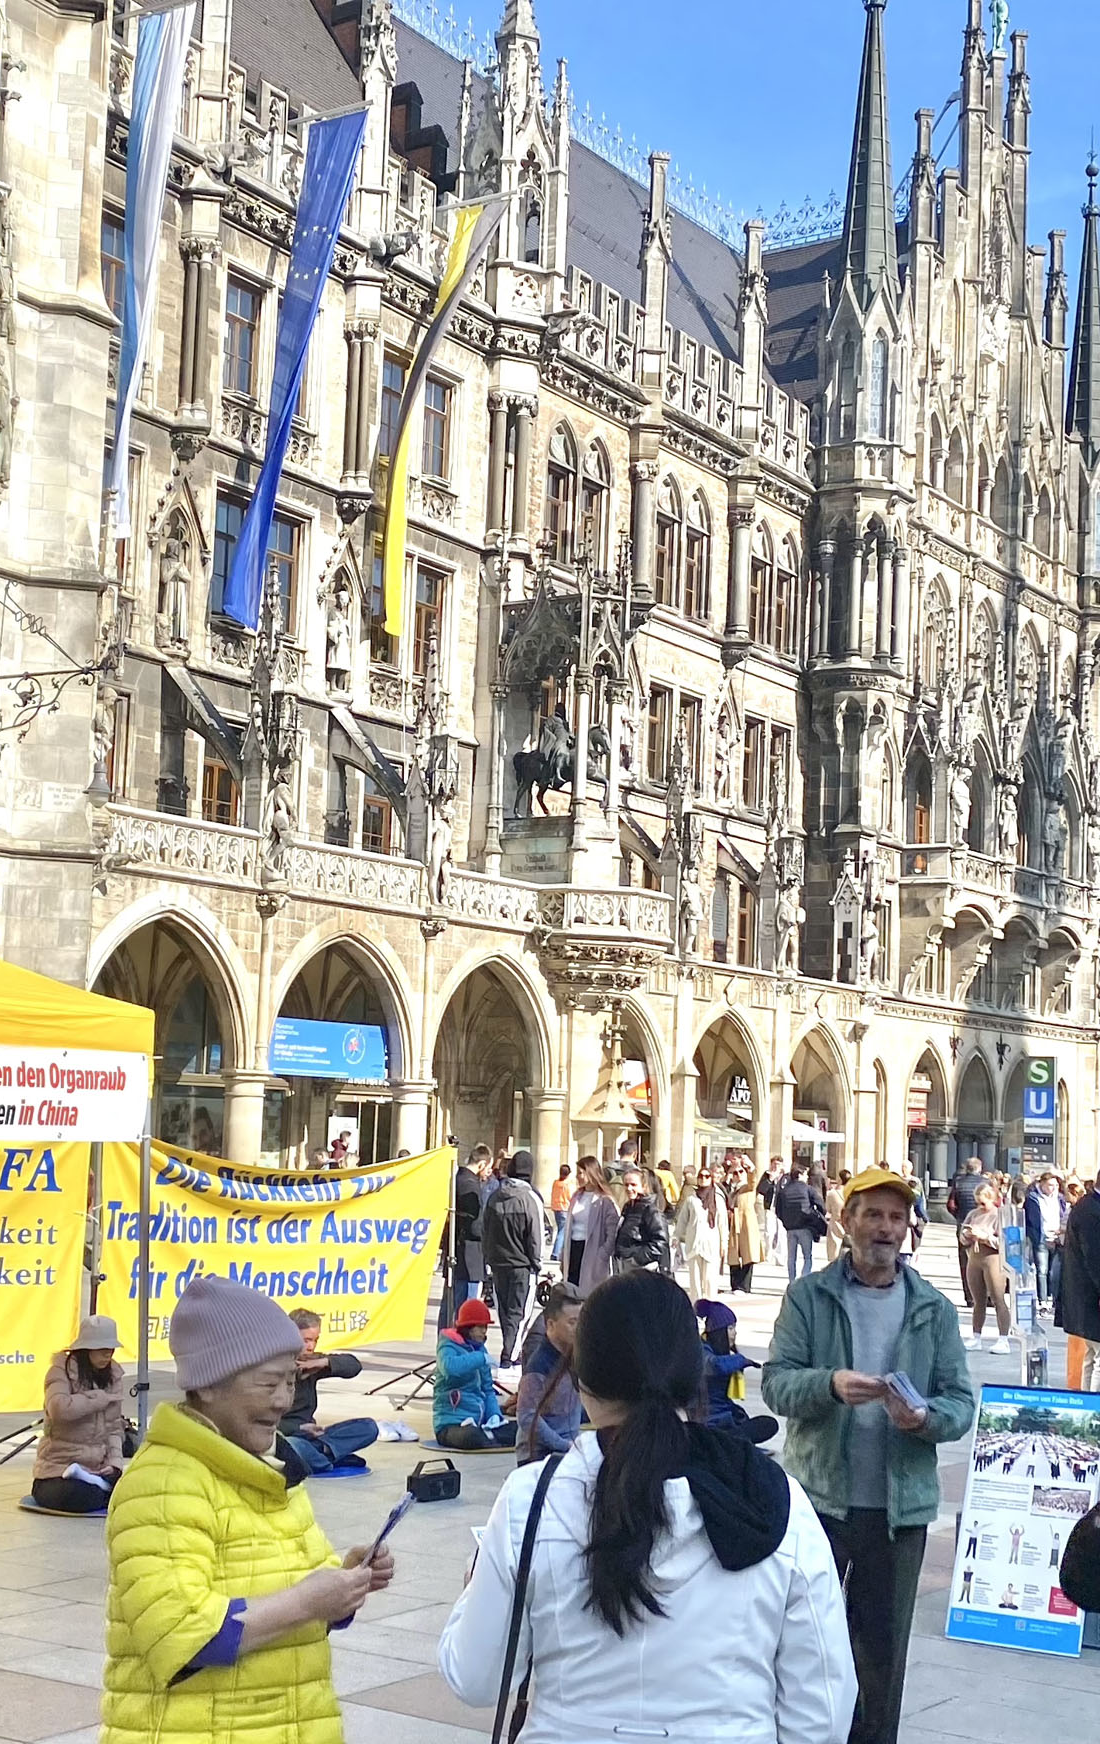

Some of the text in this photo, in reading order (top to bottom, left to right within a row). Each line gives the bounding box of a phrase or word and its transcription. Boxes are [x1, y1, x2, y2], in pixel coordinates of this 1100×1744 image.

[16, 1061, 45, 1088] den
[49, 1062, 126, 1094] Organraub
[1030, 1060, 1049, 1084] S
[730, 1087, 752, 1103] APO
[1029, 1091, 1047, 1114] U
[18, 1099, 35, 1126] in
[37, 1100, 79, 1126] China
[155, 1156, 212, 1193] Die
[217, 1166, 342, 1202] Rückkehr
[107, 1201, 432, 1255] Tradition ist der Ausweg
[229, 1257, 389, 1298] Menschheit
